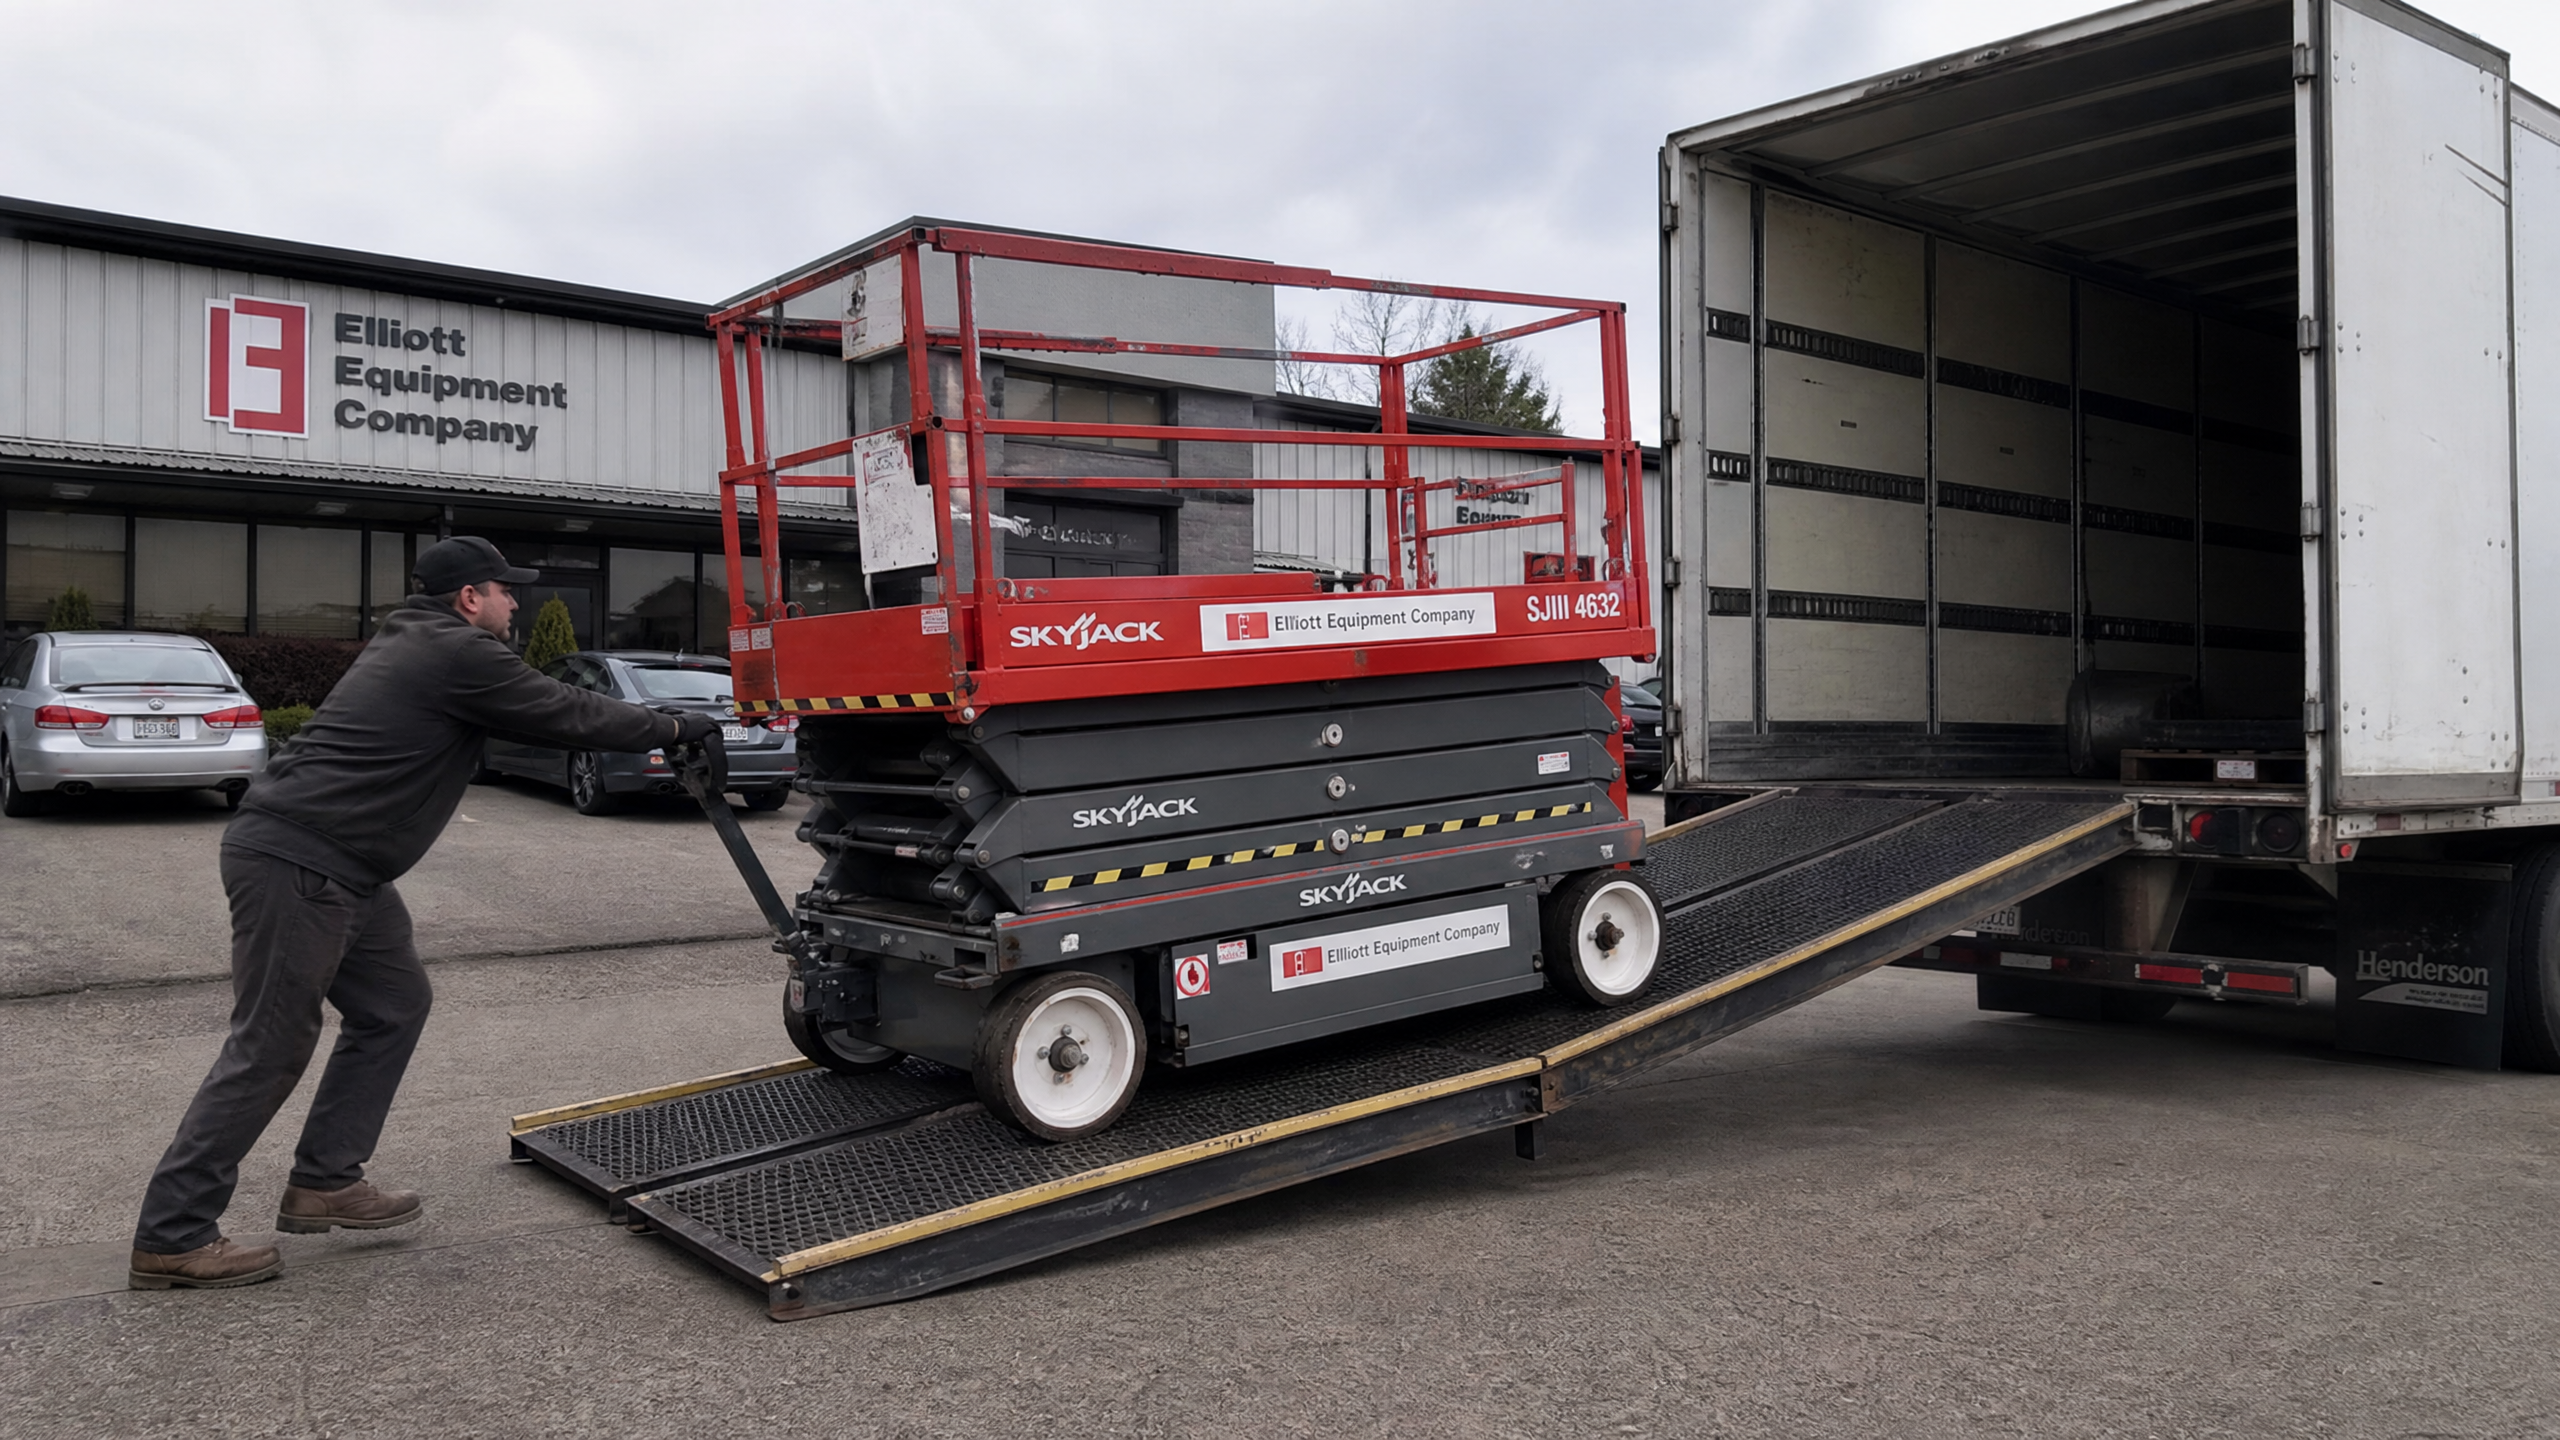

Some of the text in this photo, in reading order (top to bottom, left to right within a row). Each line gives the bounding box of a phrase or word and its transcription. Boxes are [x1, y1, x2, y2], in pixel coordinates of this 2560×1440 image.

[334, 312, 466, 357] Elliott
[334, 355, 568, 409] Equipment
[334, 398, 539, 452] Company
[1327, 611, 1407, 632] Equipment
[1410, 608, 1476, 625] Company
[1526, 592, 1621, 622] SJIII 4632
[1009, 612, 1165, 651] SKYJACK
[1072, 794, 1199, 829] SKYJACK
[1299, 872, 1408, 907] SKYJACK
[1373, 931, 1441, 956] Equipment
[1443, 922, 1501, 942] Company
[2356, 950, 2490, 986] Henderson
